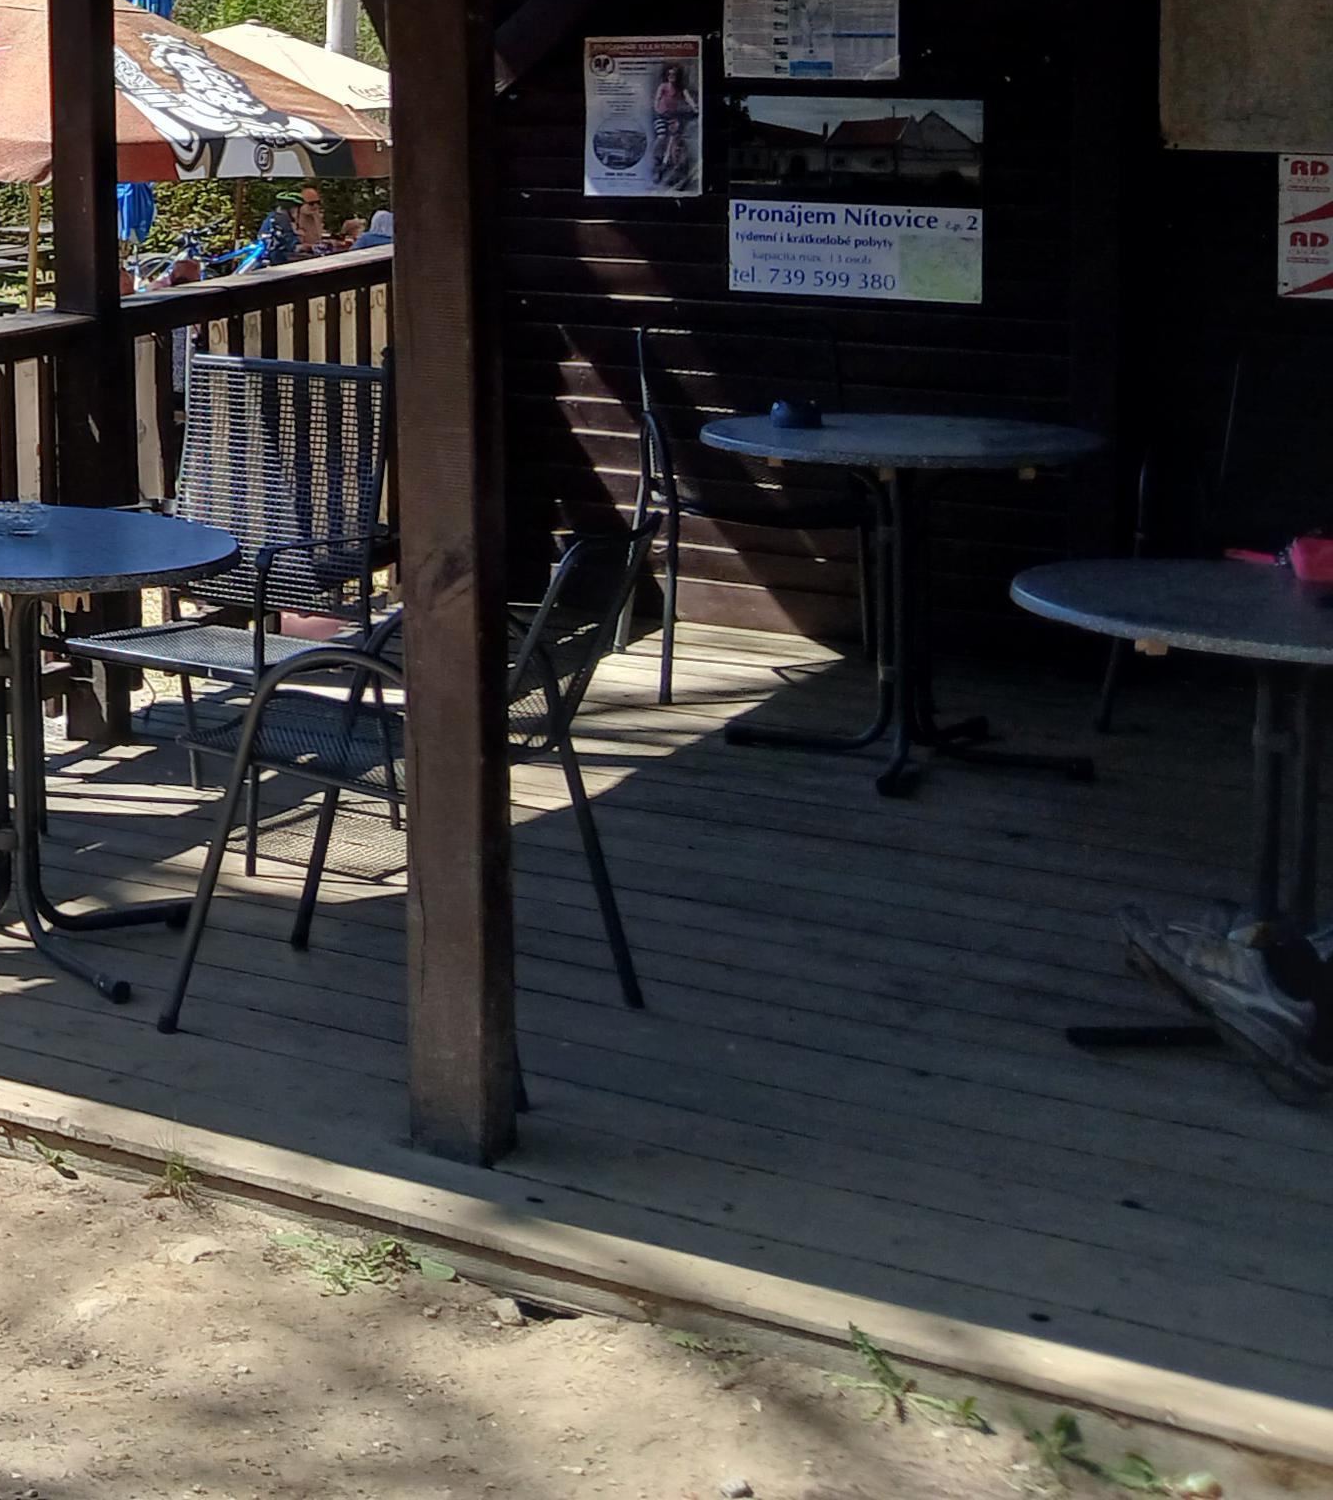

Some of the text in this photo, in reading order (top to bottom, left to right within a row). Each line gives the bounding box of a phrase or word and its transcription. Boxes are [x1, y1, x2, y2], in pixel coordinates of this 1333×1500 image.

[734, 203, 836, 227] Pronájem
[844, 207, 939, 230] Nítovice
[967, 215, 978, 231] 2
[735, 231, 777, 243] týdenní
[787, 233, 850, 246] krátkodobé
[854, 236, 893, 249] pobyty
[752, 249, 796, 263] kapacita
[733, 266, 896, 290] tel. 739 599 380
